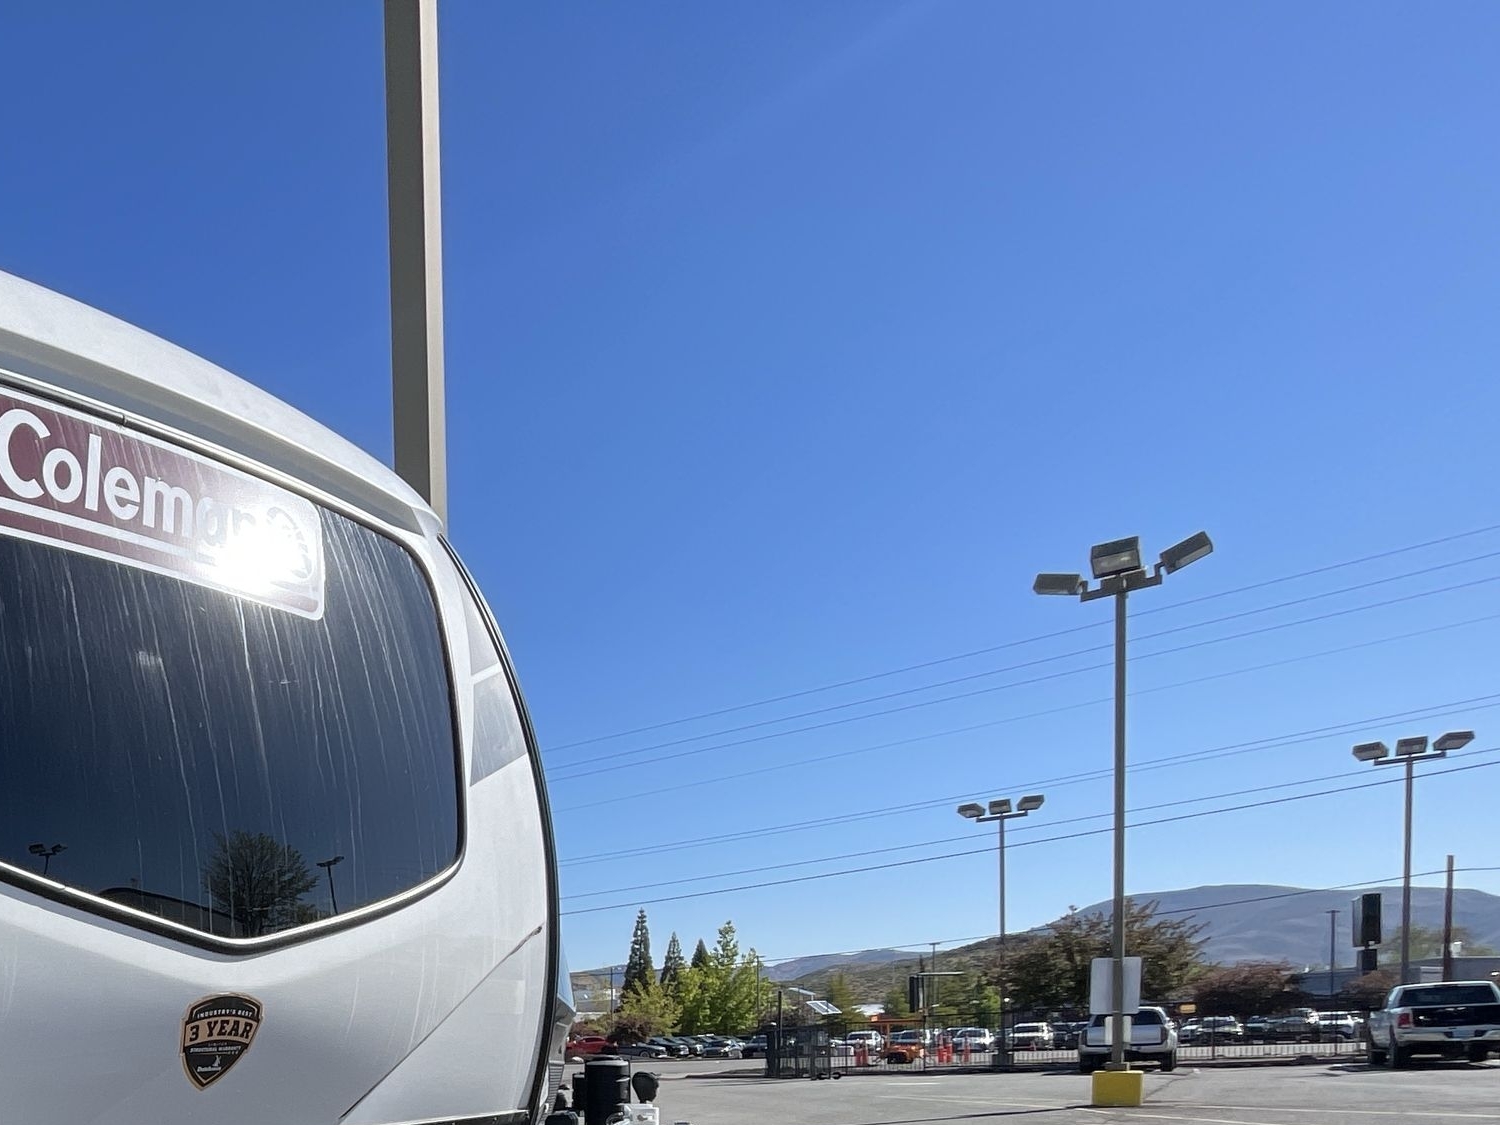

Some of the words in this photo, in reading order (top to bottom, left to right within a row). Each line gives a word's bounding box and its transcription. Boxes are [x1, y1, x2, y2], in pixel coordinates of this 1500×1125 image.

[197, 1009, 236, 1019] INDUSTRY'S
[237, 1009, 253, 1018] BEST
[189, 1024, 200, 1042] 3
[206, 1019, 254, 1040] YEAR
